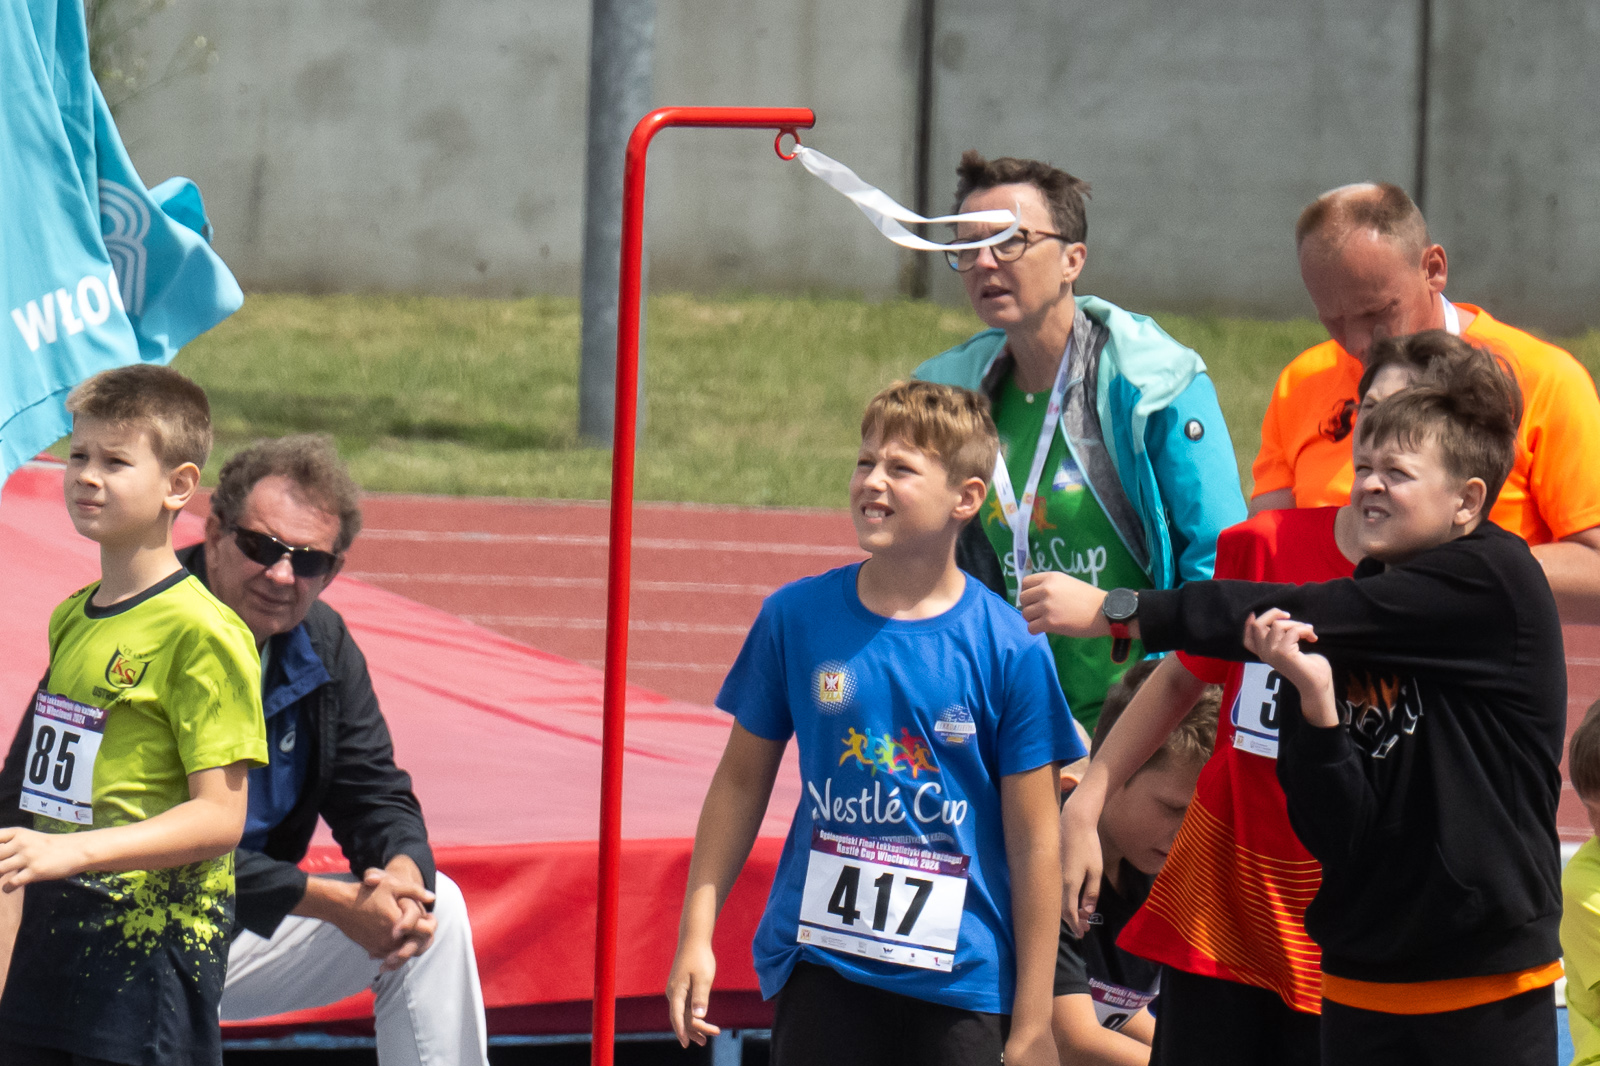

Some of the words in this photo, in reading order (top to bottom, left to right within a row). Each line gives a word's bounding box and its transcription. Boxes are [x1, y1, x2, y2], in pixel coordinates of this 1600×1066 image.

[1050, 537, 1107, 588] Cup
[111, 657, 136, 685] KS
[28, 725, 82, 792] 85
[808, 777, 906, 824] Nestlé
[860, 847, 876, 861] Cup
[920, 858, 940, 871] 2024
[827, 864, 934, 936] 417
